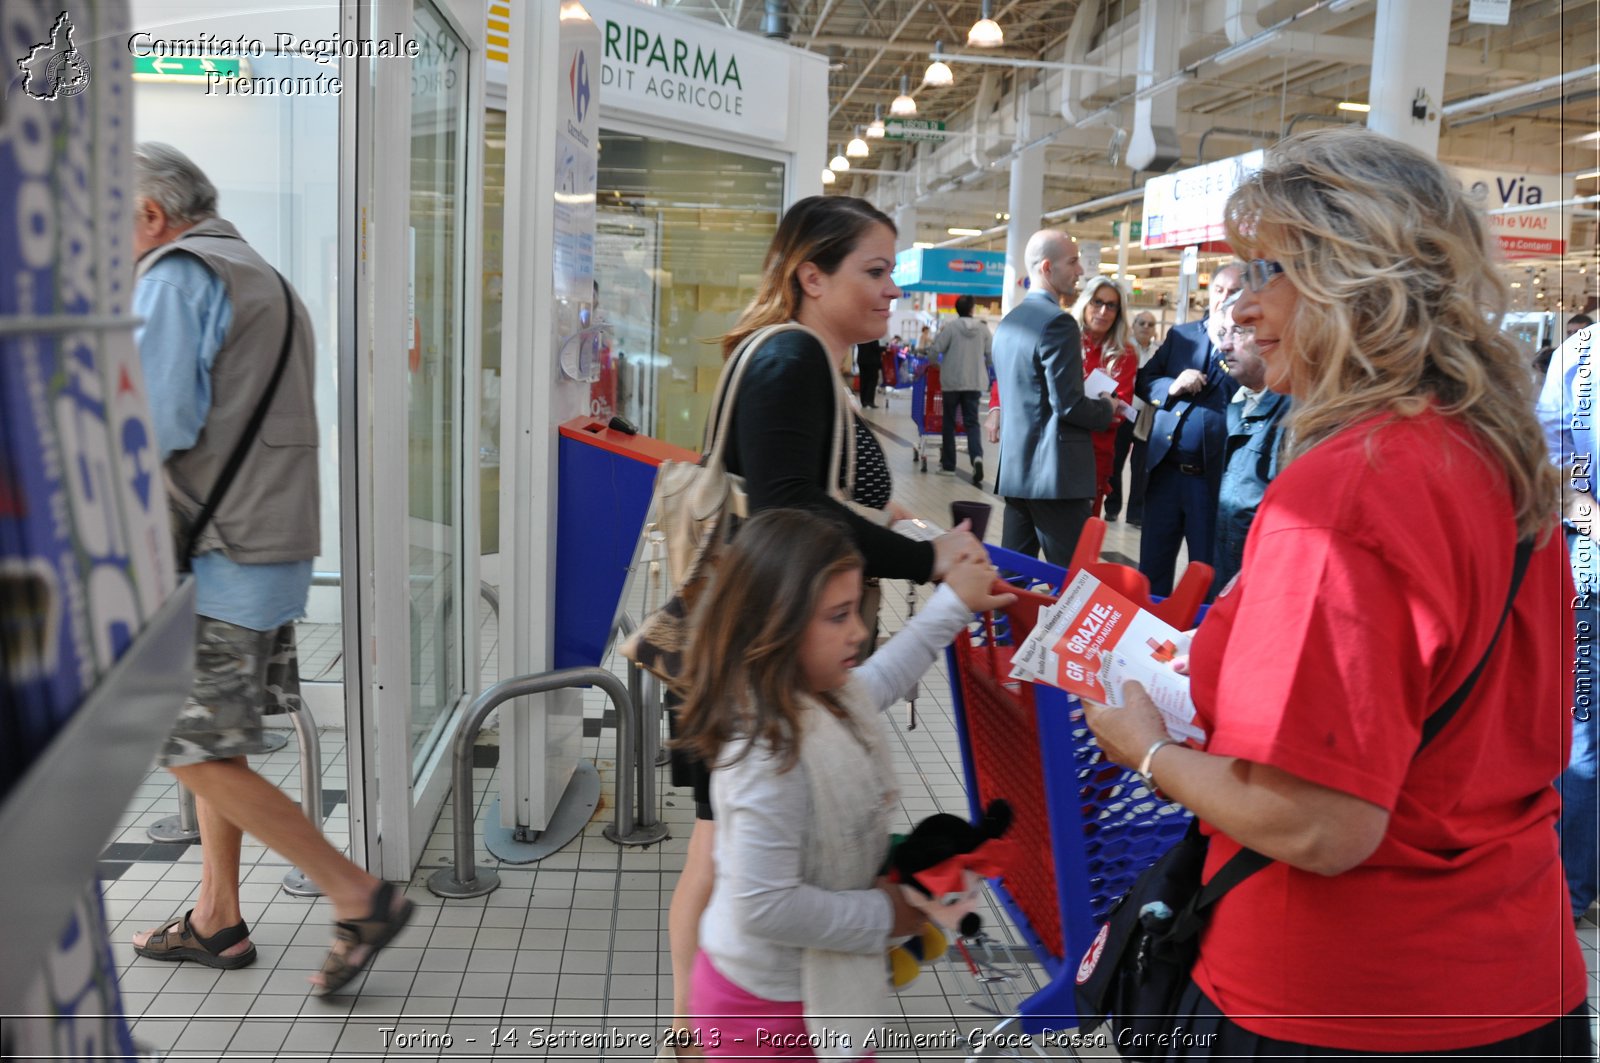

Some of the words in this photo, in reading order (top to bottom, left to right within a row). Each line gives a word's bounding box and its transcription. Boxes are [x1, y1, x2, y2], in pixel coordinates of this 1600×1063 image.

[605, 19, 742, 91] RIPARMA
[601, 64, 634, 91] DIT
[645, 76, 742, 116] AGRICOLE
[1496, 176, 1543, 205] Via
[1519, 215, 1548, 230] VIA!
[1045, 609, 1063, 632] Alimentare
[1064, 586, 1081, 606] settembre
[1078, 573, 1089, 586] 2013
[1095, 634, 1105, 645] AD
[1100, 610, 1121, 637] AIUTARE
[1066, 603, 1113, 654] GRAZIE.
